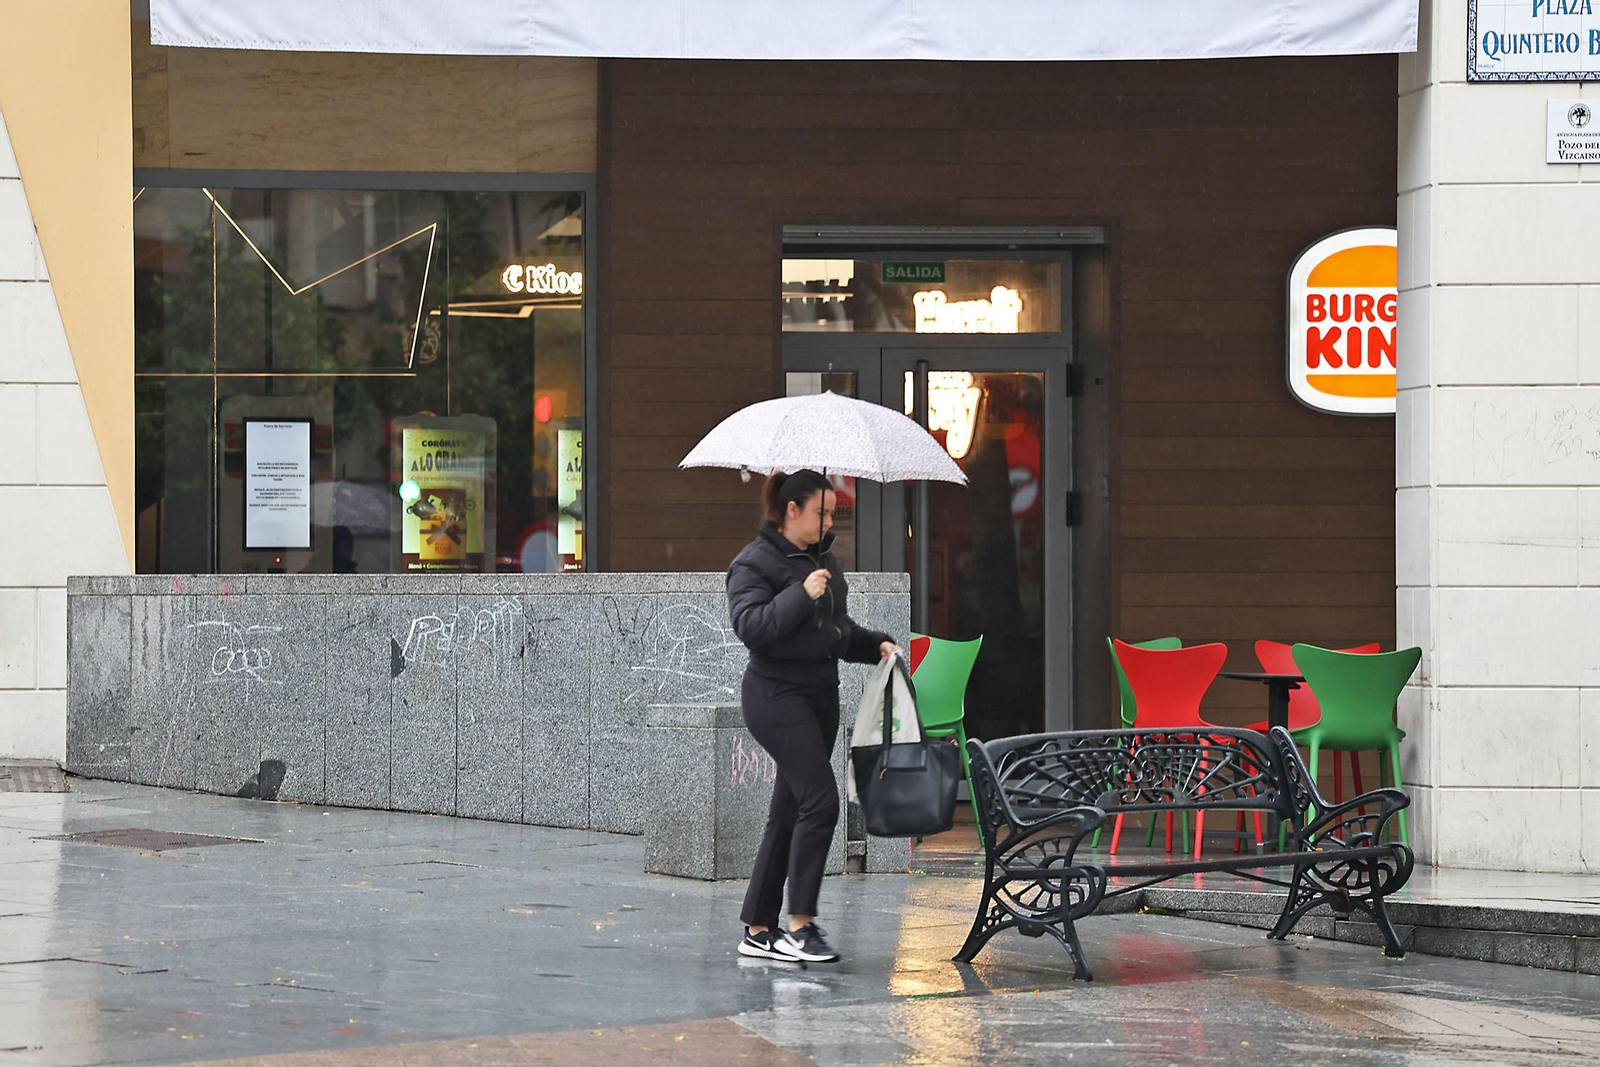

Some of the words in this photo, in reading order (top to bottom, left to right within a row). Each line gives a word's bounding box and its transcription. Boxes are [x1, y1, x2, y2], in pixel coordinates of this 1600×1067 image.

[1532, 0, 1593, 18] PLAZA
[1482, 30, 1580, 61] QUINTERO
[1558, 139, 1583, 150] POZO
[885, 265, 942, 278] SALIDA
[1306, 293, 1397, 323] BURG
[1306, 326, 1397, 369] KIN
